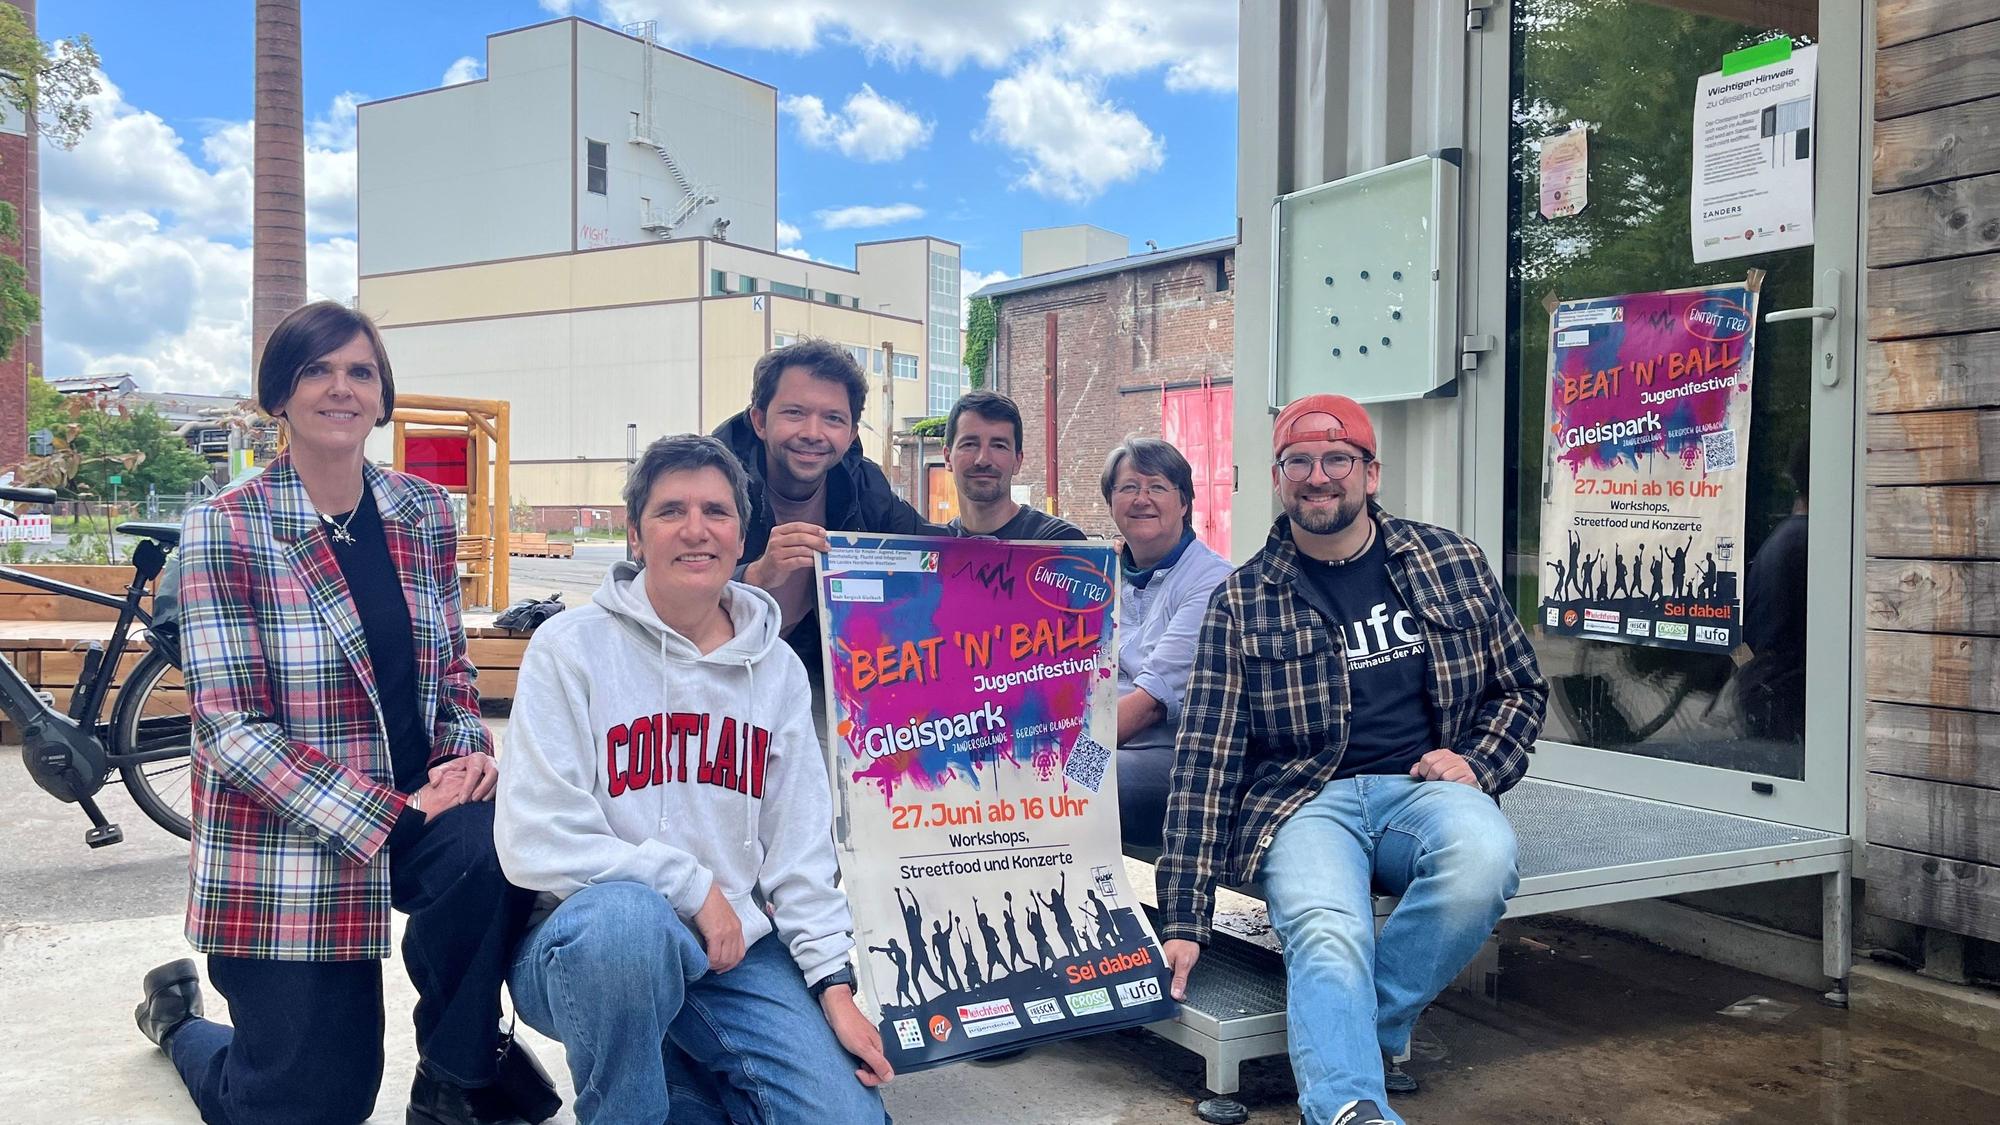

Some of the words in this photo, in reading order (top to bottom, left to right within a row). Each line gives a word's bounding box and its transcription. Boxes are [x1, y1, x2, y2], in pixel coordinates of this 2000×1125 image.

[1706, 101, 1718, 109] zu
[1719, 92, 1752, 106] diesem
[1752, 78, 1800, 97] Container
[1708, 79, 1755, 97] Wichtiger
[1755, 68, 1794, 84] Hinweis
[1703, 206, 1742, 219] ZANDERS
[753, 297, 762, 311] K
[1689, 308, 1723, 328] EINTRITT
[1726, 316, 1747, 332] FREI
[1563, 365, 1623, 405] BEAT
[1668, 342, 1741, 382] BALL
[1640, 373, 1738, 405] Jugendfestival
[1565, 411, 1662, 449] Gleispark
[1641, 480, 1662, 496] ab
[1667, 481, 1685, 497] 16
[1689, 481, 1723, 498] Uhr
[1610, 500, 1670, 514] Workshops,
[1574, 516, 1628, 529] Streetfood
[1630, 518, 1650, 529] und
[1652, 521, 1702, 532] Konzerte
[1034, 566, 1080, 593] EINTRITT
[1083, 582, 1107, 602] FREI
[1664, 602, 1685, 617] Sei
[1688, 604, 1731, 619] dabei!
[1658, 624, 1687, 635] CROSS
[1705, 629, 1727, 641] ufo
[852, 636, 945, 691] BEAT
[1010, 615, 1099, 661] BALL
[1392, 649, 1410, 660] der
[973, 656, 1099, 693] Jugendfestival
[864, 702, 1006, 759] Gleispark
[1015, 723, 1048, 739] BERGISCH
[1049, 716, 1084, 732] GLADBACH
[988, 800, 1015, 822] ab
[1019, 797, 1044, 821] 16
[1050, 795, 1089, 818] Uhr
[949, 830, 1030, 849] Workshops,
[900, 859, 981, 880] Streetfood
[984, 856, 1010, 872] und
[1012, 852, 1073, 870] Konzerte
[1066, 961, 1097, 986] Sei
[1099, 947, 1152, 977] dabei!
[1072, 990, 1106, 1009] CROSS
[1129, 980, 1158, 999] ufo
[968, 1003, 1013, 1018] leichtsinn
